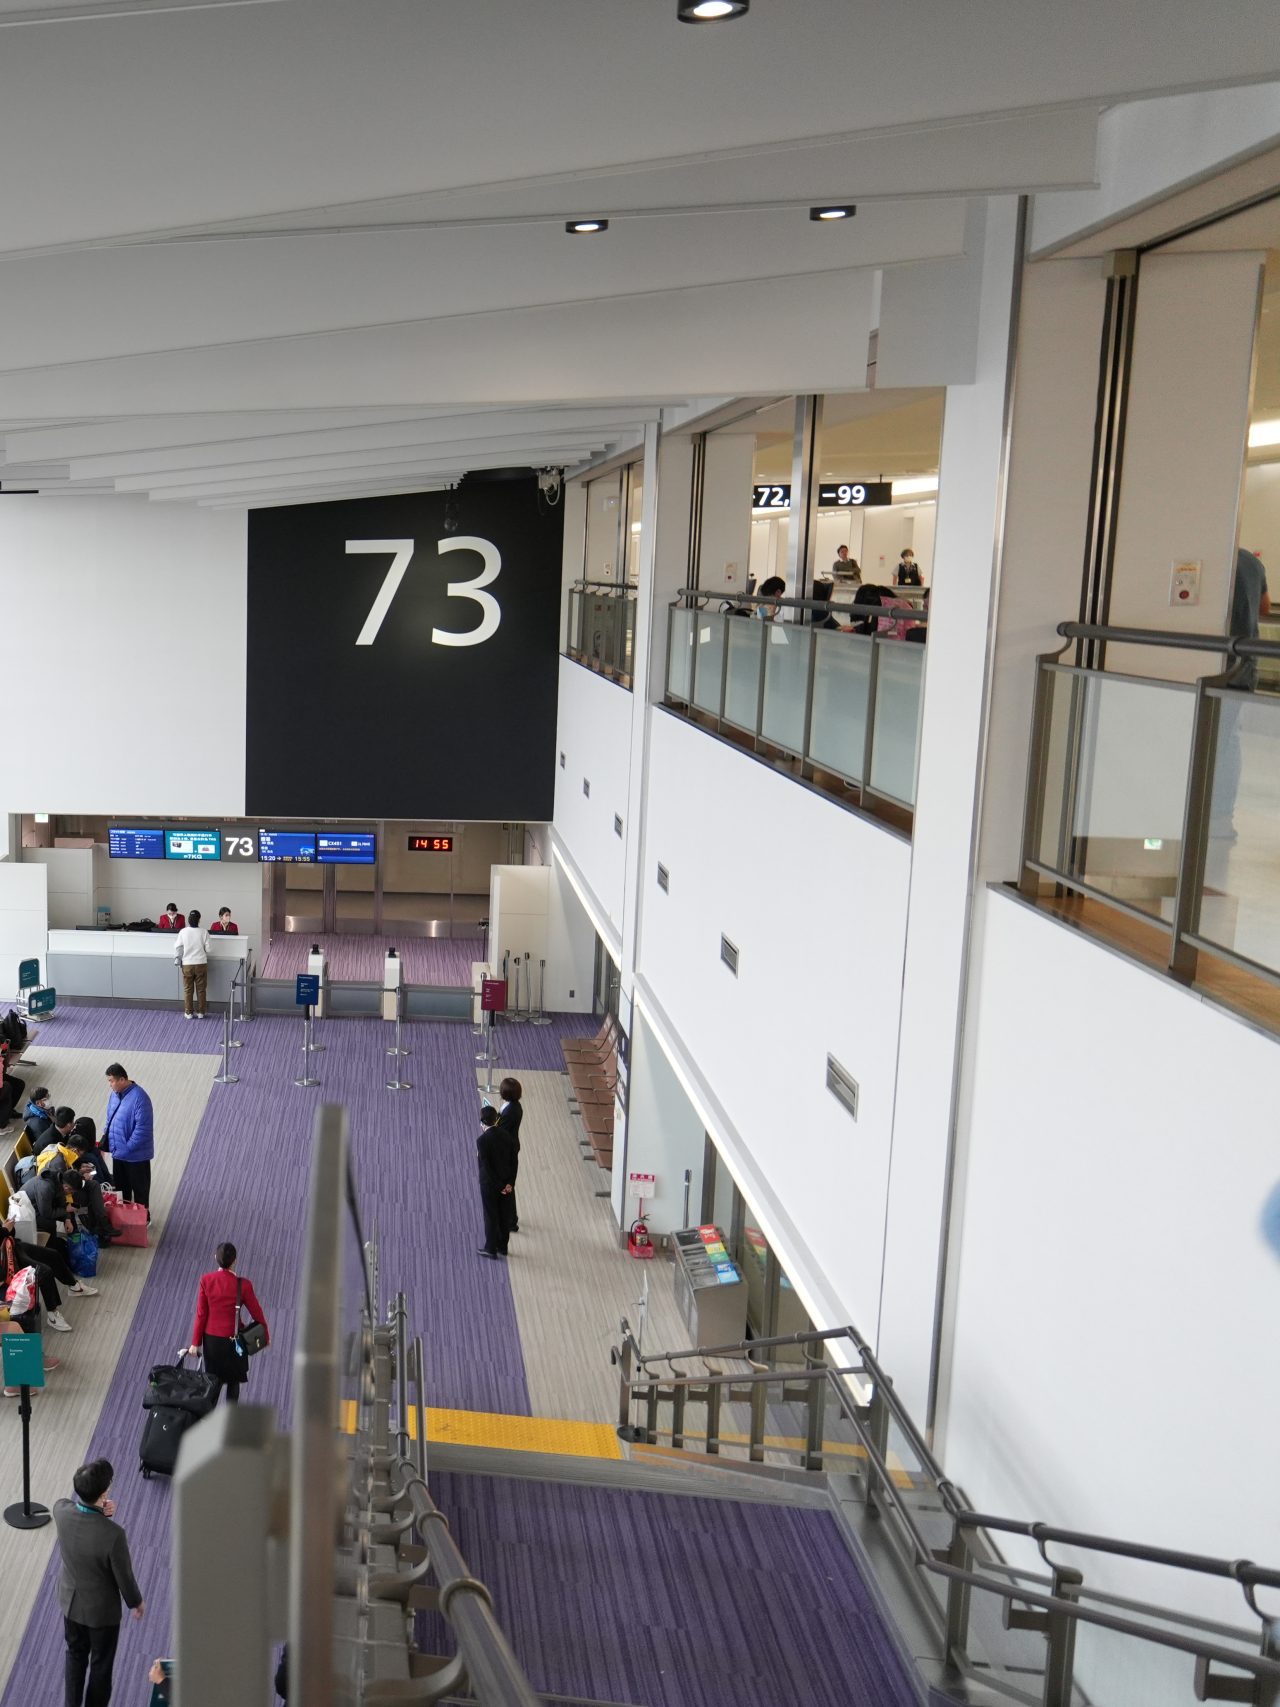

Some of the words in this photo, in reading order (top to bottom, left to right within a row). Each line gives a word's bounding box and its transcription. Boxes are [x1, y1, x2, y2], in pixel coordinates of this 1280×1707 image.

[753, 487, 790, 507] 72,
[345, 535, 502, 647] 73
[225, 837, 254, 856] 73
